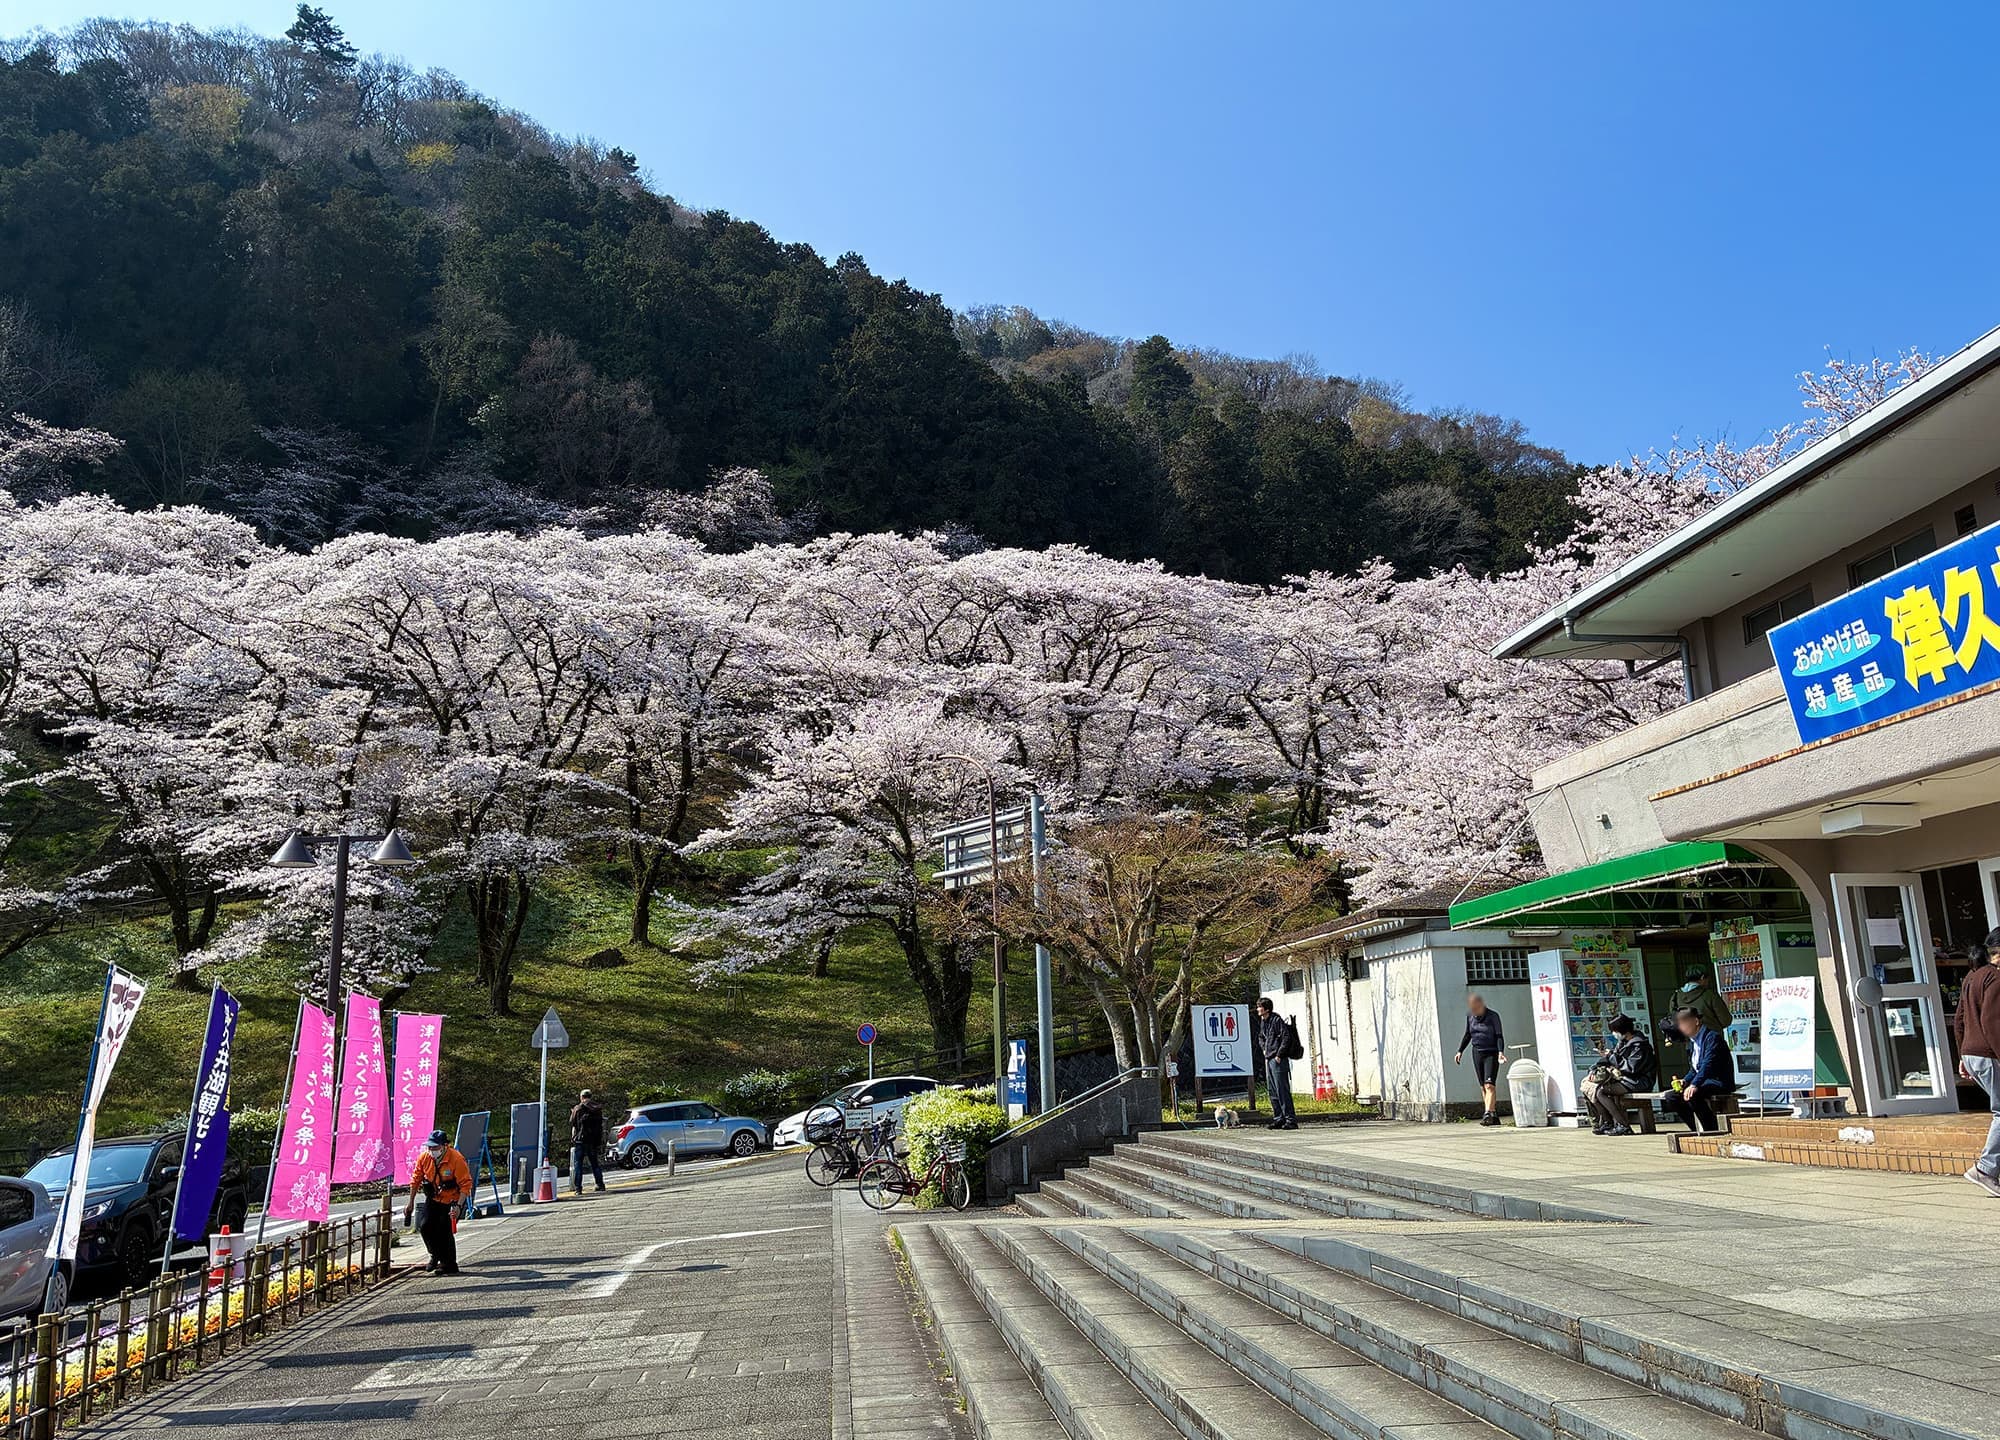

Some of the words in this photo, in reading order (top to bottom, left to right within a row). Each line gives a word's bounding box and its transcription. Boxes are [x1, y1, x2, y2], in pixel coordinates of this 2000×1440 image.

[1792, 618, 1873, 672] おみやげ品
[1884, 546, 2000, 694] 津久
[1805, 661, 1887, 713] 特産品
[349, 1051, 370, 1136] さくら祭り
[417, 1024, 435, 1087] 津久井湖
[293, 1070, 318, 1165] さくら祭り
[398, 1067, 416, 1143] さくら祭り
